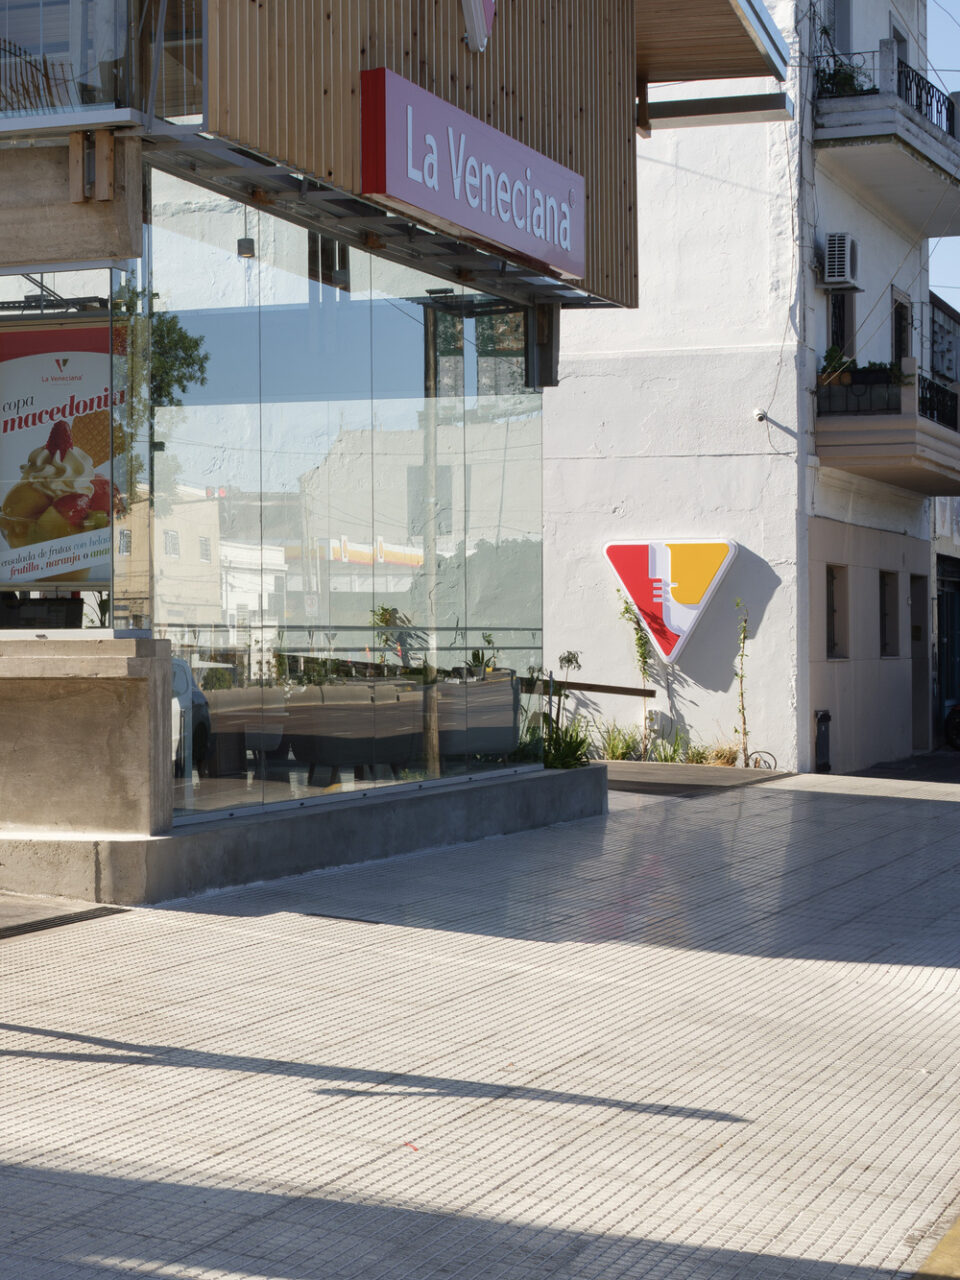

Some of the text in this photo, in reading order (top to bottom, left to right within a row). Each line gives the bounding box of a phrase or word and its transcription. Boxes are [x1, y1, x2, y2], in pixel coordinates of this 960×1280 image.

[407, 104, 571, 252] La Veneciana
[2, 395, 34, 415] copa
[2, 387, 126, 434] macedonia
[0, 551, 36, 568] ensalada
[37, 548, 47, 559] de
[48, 544, 72, 560] frutas
[73, 541, 87, 551] con
[45, 552, 81, 569] naranja
